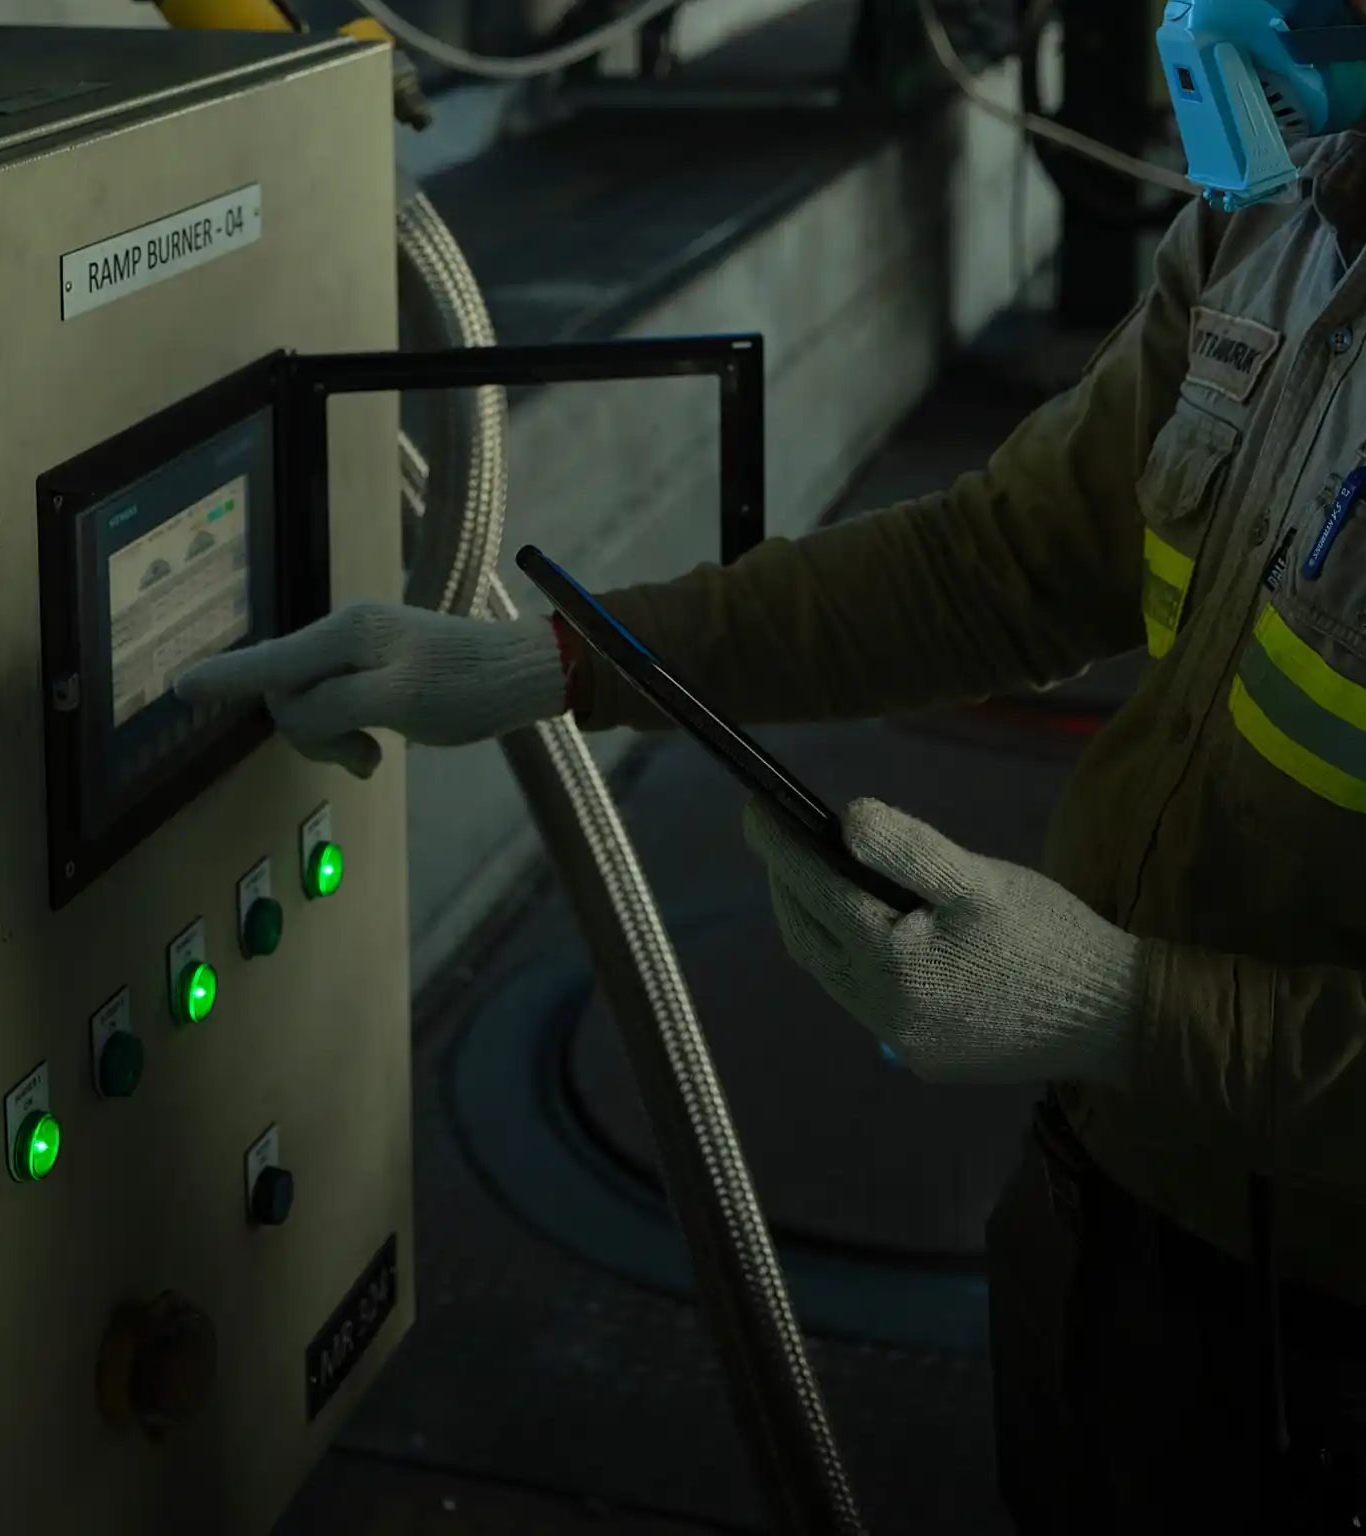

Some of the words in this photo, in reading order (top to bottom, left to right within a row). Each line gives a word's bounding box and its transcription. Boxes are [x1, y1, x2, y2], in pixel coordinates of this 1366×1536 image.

[89, 246, 142, 293] RAMP
[147, 218, 213, 270] BURNER
[225, 205, 244, 238] 04
[1313, 520, 1333, 559] SNOWMAN
